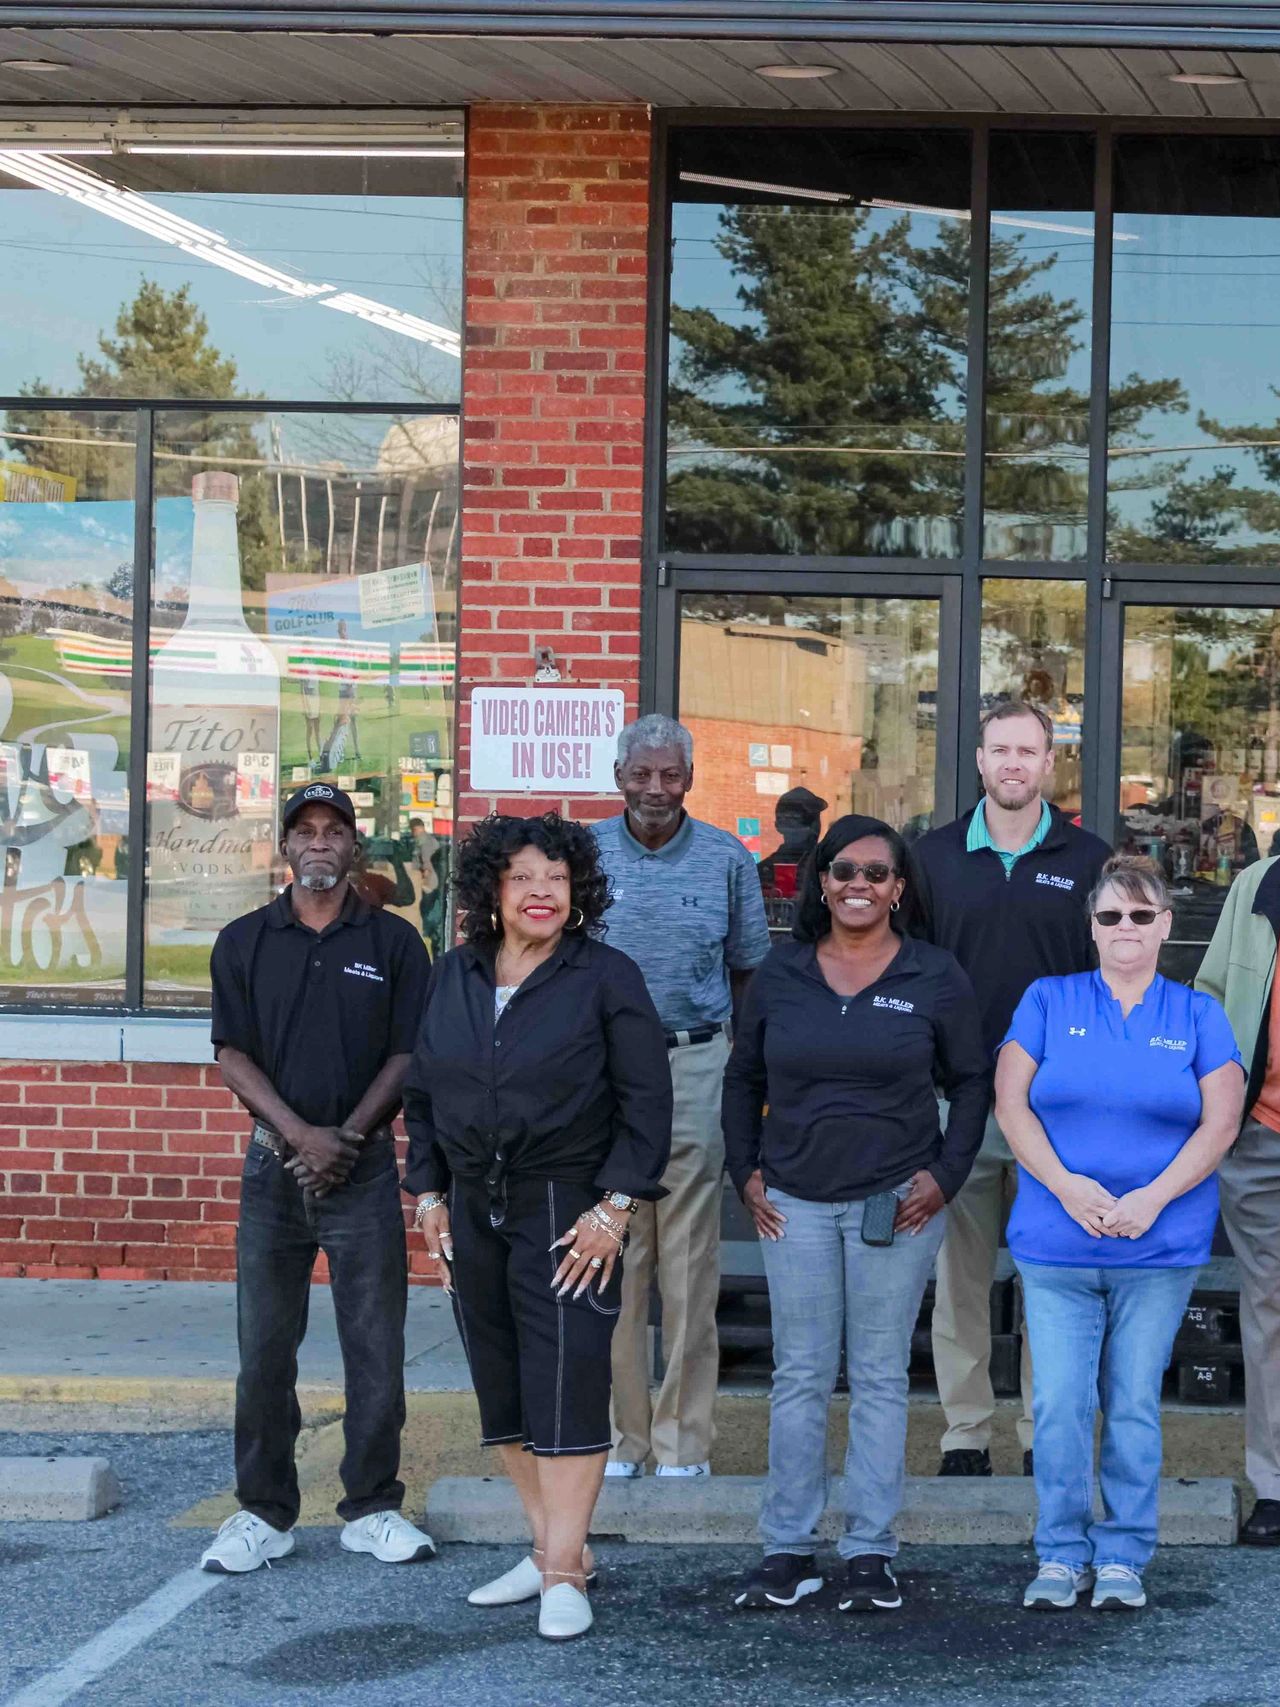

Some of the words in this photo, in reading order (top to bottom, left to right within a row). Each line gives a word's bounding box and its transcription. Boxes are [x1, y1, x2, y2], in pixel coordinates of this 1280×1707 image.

[275, 615, 304, 631] GOLF
[305, 611, 335, 626] CLUB
[481, 699, 529, 736] VIDEO
[534, 699, 616, 737] CAMERA'S
[164, 715, 266, 752] Tito's
[512, 742, 534, 778] IN
[541, 742, 591, 779] USE!
[155, 826, 252, 855] Handma
[179, 863, 248, 875] VODKA
[1197, 1371, 1212, 1381] A-B
